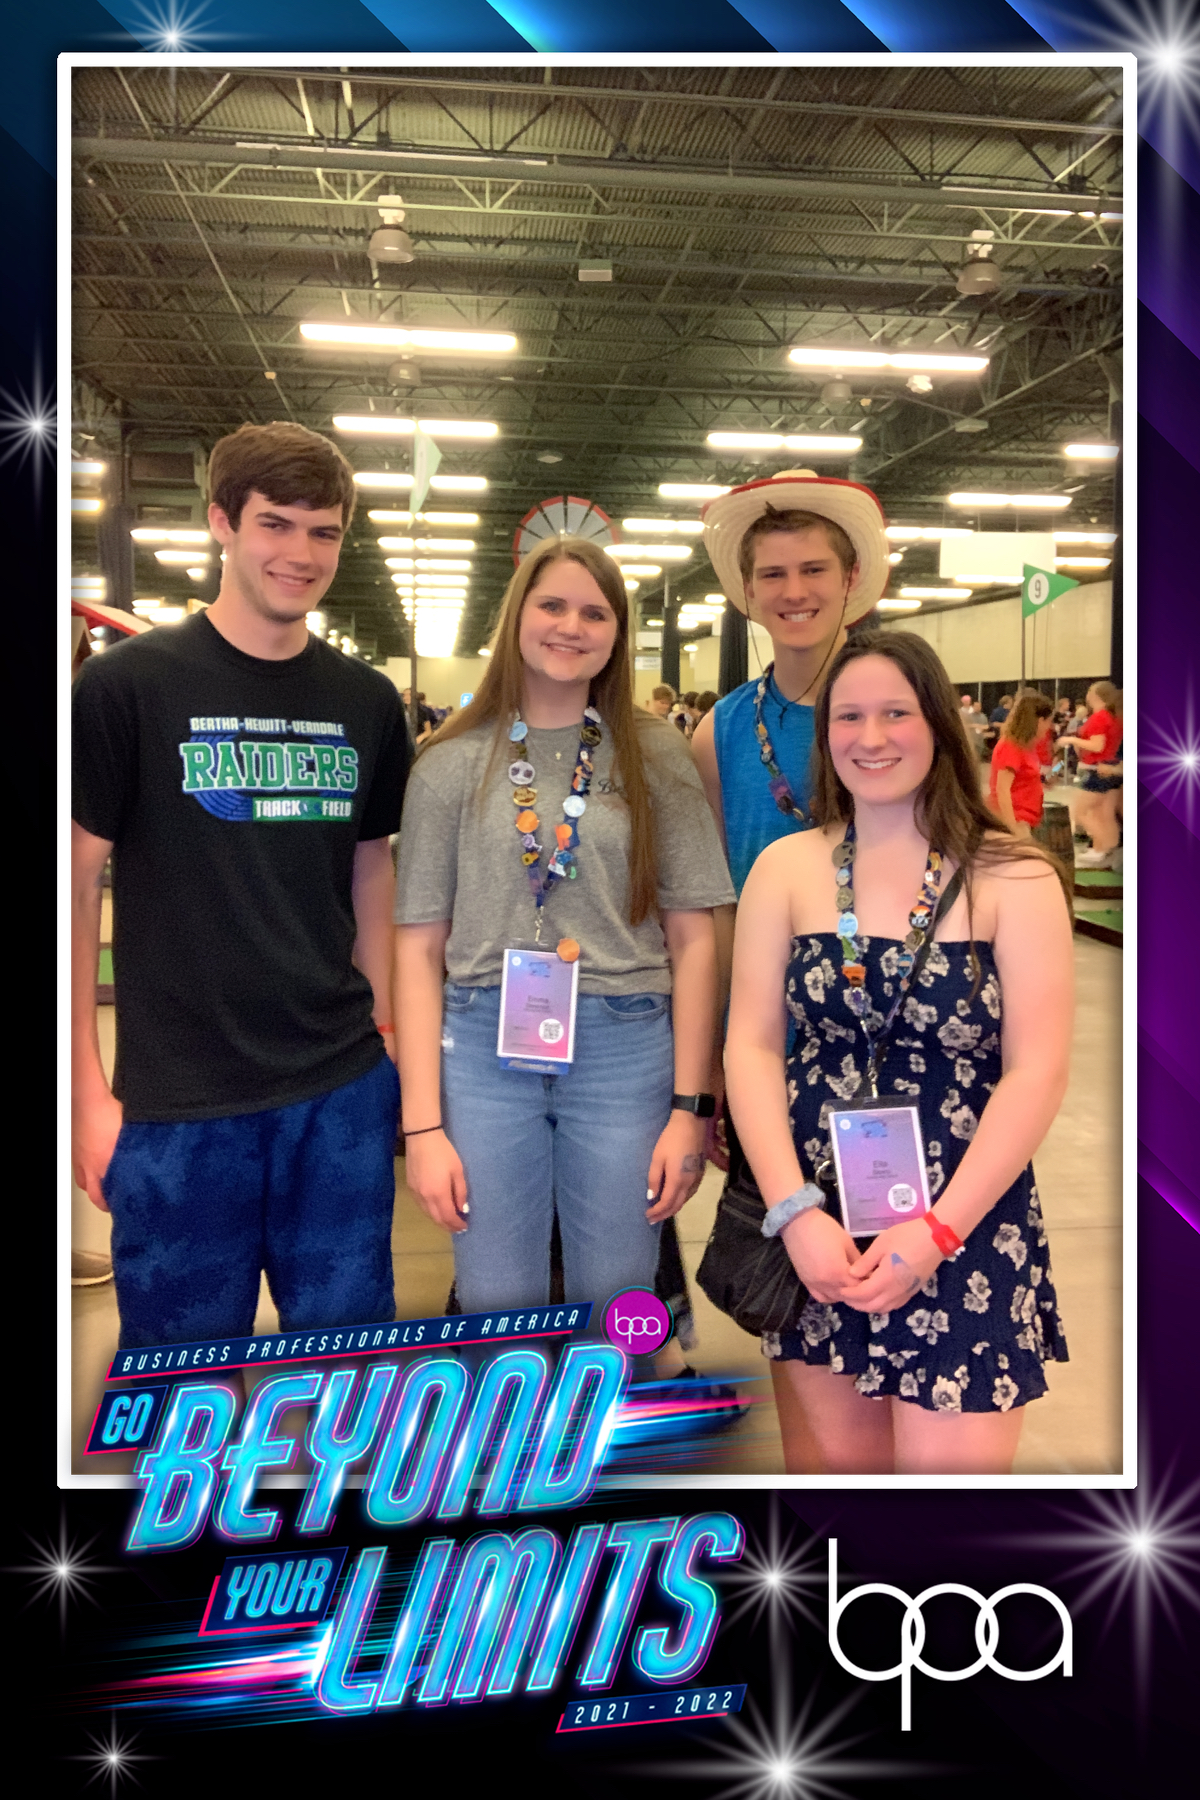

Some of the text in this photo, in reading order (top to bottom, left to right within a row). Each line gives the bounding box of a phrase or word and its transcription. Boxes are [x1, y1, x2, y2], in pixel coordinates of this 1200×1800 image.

[1034, 579, 1042, 599] 9
[179, 741, 358, 792] RAIDERS
[322, 800, 352, 818] FIELD
